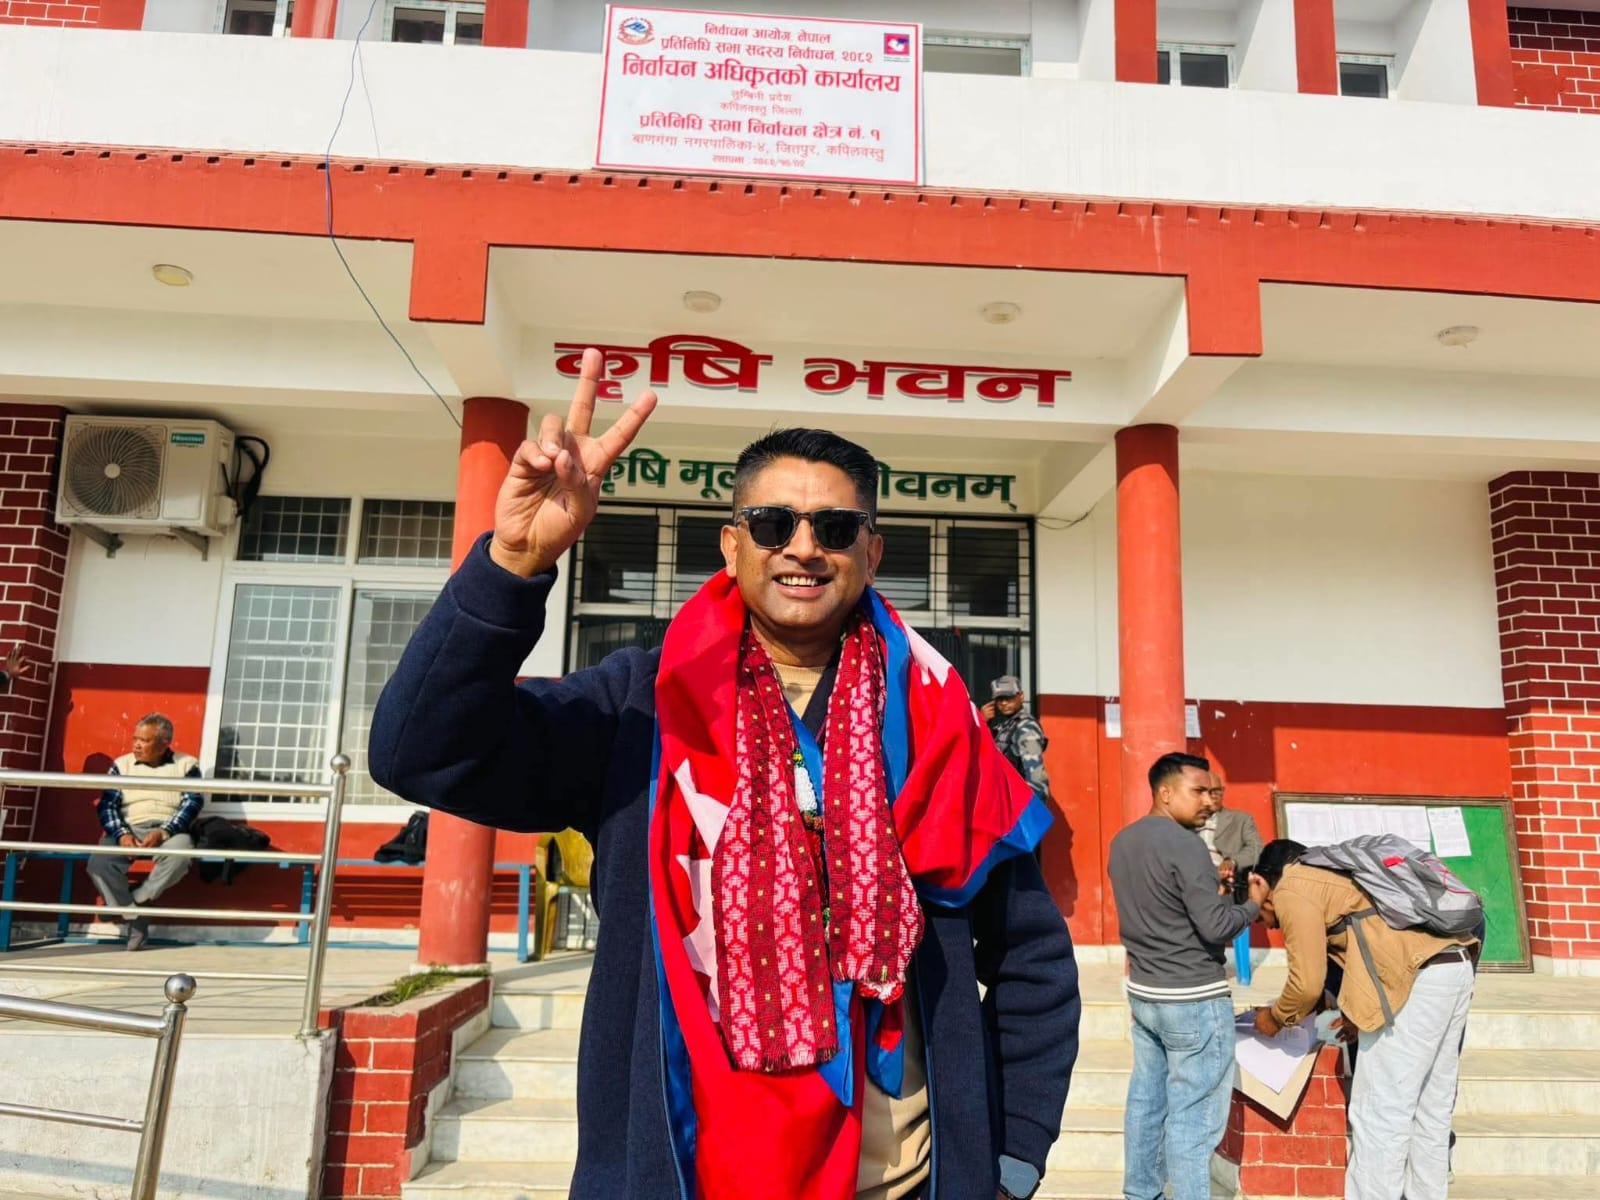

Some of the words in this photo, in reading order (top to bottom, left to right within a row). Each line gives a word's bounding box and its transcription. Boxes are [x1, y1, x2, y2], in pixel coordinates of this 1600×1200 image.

[705, 22, 748, 37] निर्वाचन
[798, 29, 831, 44] नेपाल
[661, 35, 711, 51] प्रतिनिधि
[715, 42, 741, 54] सभा
[746, 43, 784, 58] सदस्य
[842, 51, 873, 63] २०८२
[622, 52, 698, 77] निर्वाचन
[704, 58, 808, 88] अधिकृतको
[815, 68, 901, 93] कार्यालय
[720, 102, 767, 116] कपिलवस्तु
[772, 105, 802, 117] जिल्ला
[769, 93, 792, 103] प्रदेश
[640, 111, 703, 130] प्रतिनिधि
[708, 119, 742, 133] सभा
[748, 118, 808, 138] निर्वाचन
[813, 122, 843, 139] क्षेत्र
[871, 129, 880, 141] १
[632, 134, 678, 147] बाणगंगा
[827, 143, 885, 162] कपिलवस्तु
[554, 334, 773, 402] कृषि
[804, 356, 1072, 407] भवन
